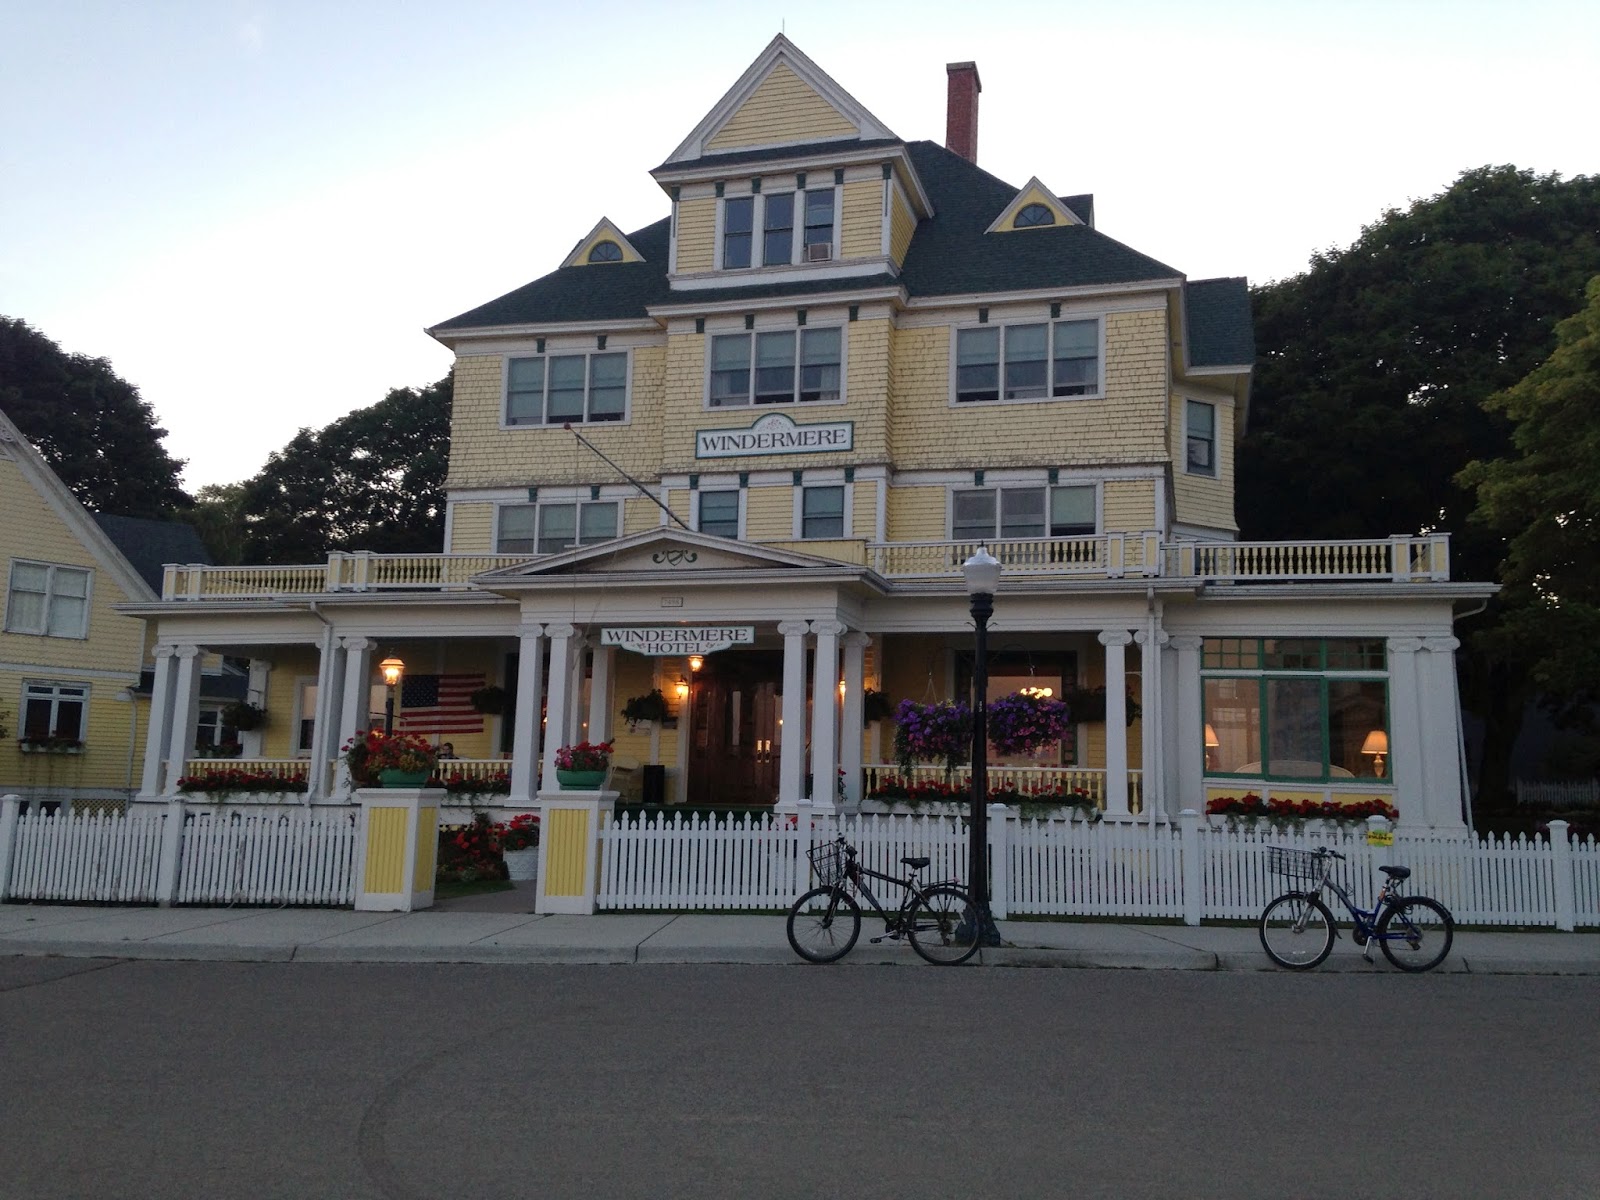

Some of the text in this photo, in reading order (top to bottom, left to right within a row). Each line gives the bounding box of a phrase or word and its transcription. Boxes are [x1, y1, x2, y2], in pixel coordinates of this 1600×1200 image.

[701, 429, 847, 451] WINDERMERE
[606, 628, 749, 642] WINDERMERE
[647, 642, 706, 653] HOTEL
